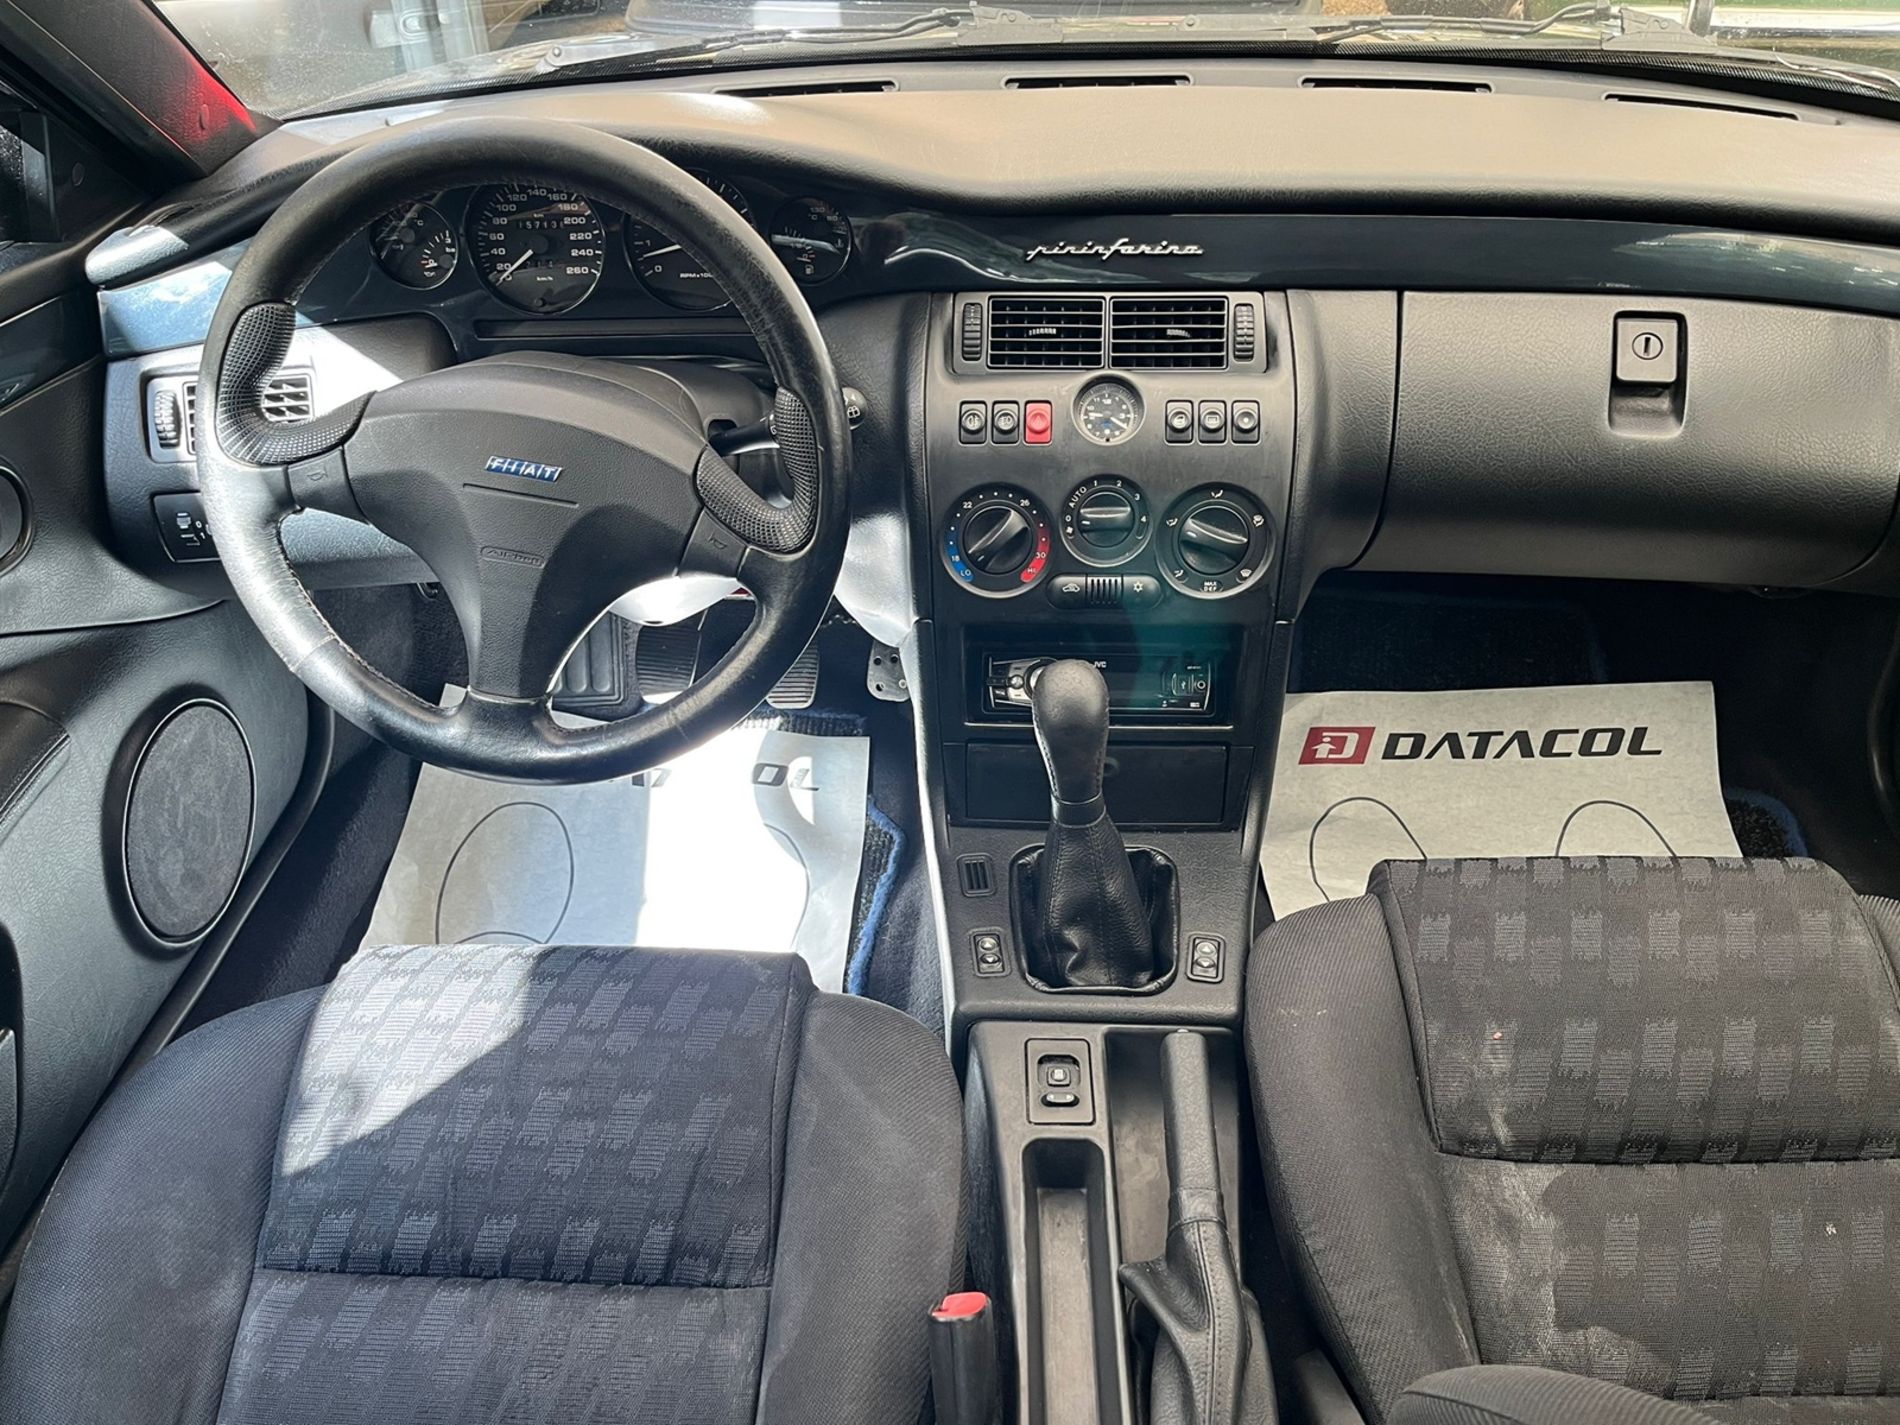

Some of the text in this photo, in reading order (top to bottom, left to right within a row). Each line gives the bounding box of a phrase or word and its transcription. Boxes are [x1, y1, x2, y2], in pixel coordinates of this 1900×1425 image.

[527, 188, 547, 196] 140
[507, 193, 527, 201] 120
[496, 203, 516, 211] 100
[558, 203, 578, 211] 180
[492, 217, 508, 225] 80
[563, 217, 586, 225] 200
[489, 232, 504, 241] 60
[569, 232, 592, 240] 220
[490, 247, 506, 255] 40
[570, 248, 594, 257] 240
[1026, 238, 1203, 261] pininfarina
[496, 263, 512, 271] 20
[566, 266, 589, 275] 260
[654, 265, 663, 273] 0
[488, 456, 559, 481] FIAT
[1068, 486, 1088, 508] AUTO
[1134, 493, 1141, 501] 3
[963, 501, 973, 509] 22
[1381, 726, 1663, 761] DATACOL
